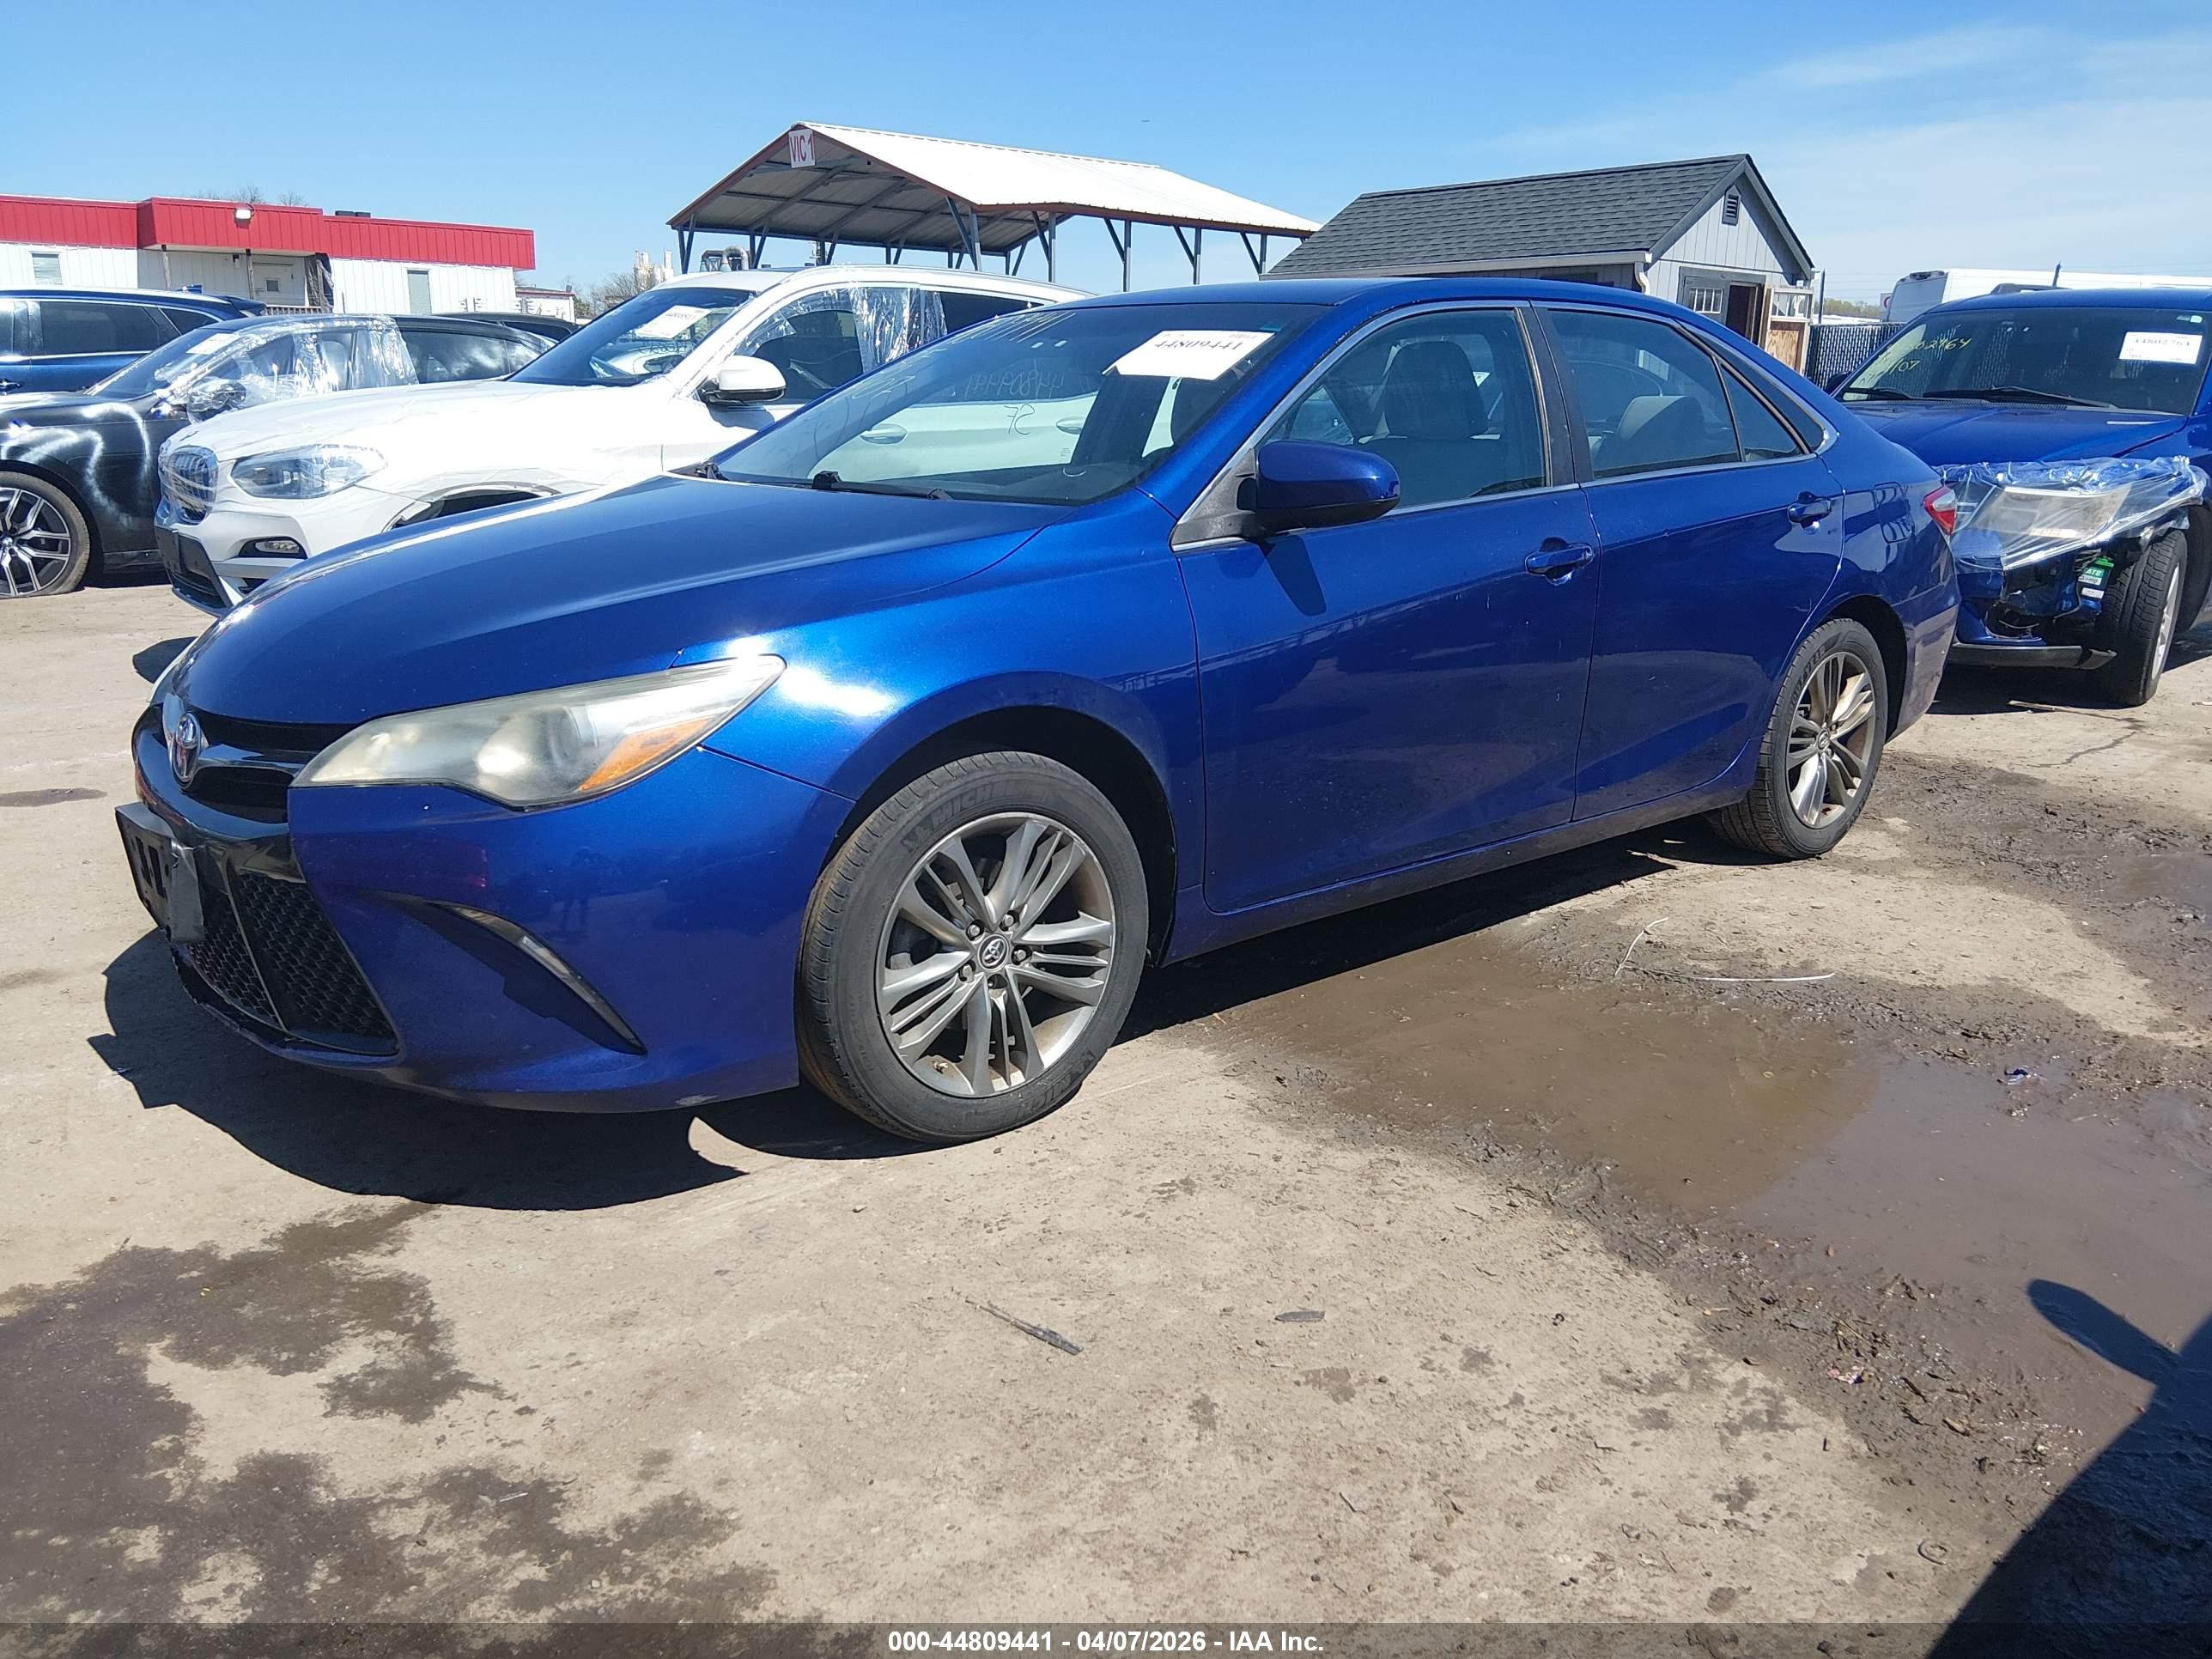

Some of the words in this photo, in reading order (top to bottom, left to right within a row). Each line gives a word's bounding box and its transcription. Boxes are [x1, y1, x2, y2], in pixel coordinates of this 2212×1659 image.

[790, 135, 807, 162] VIC
[808, 133, 814, 161] 1
[1153, 339, 1243, 351] 44809441
